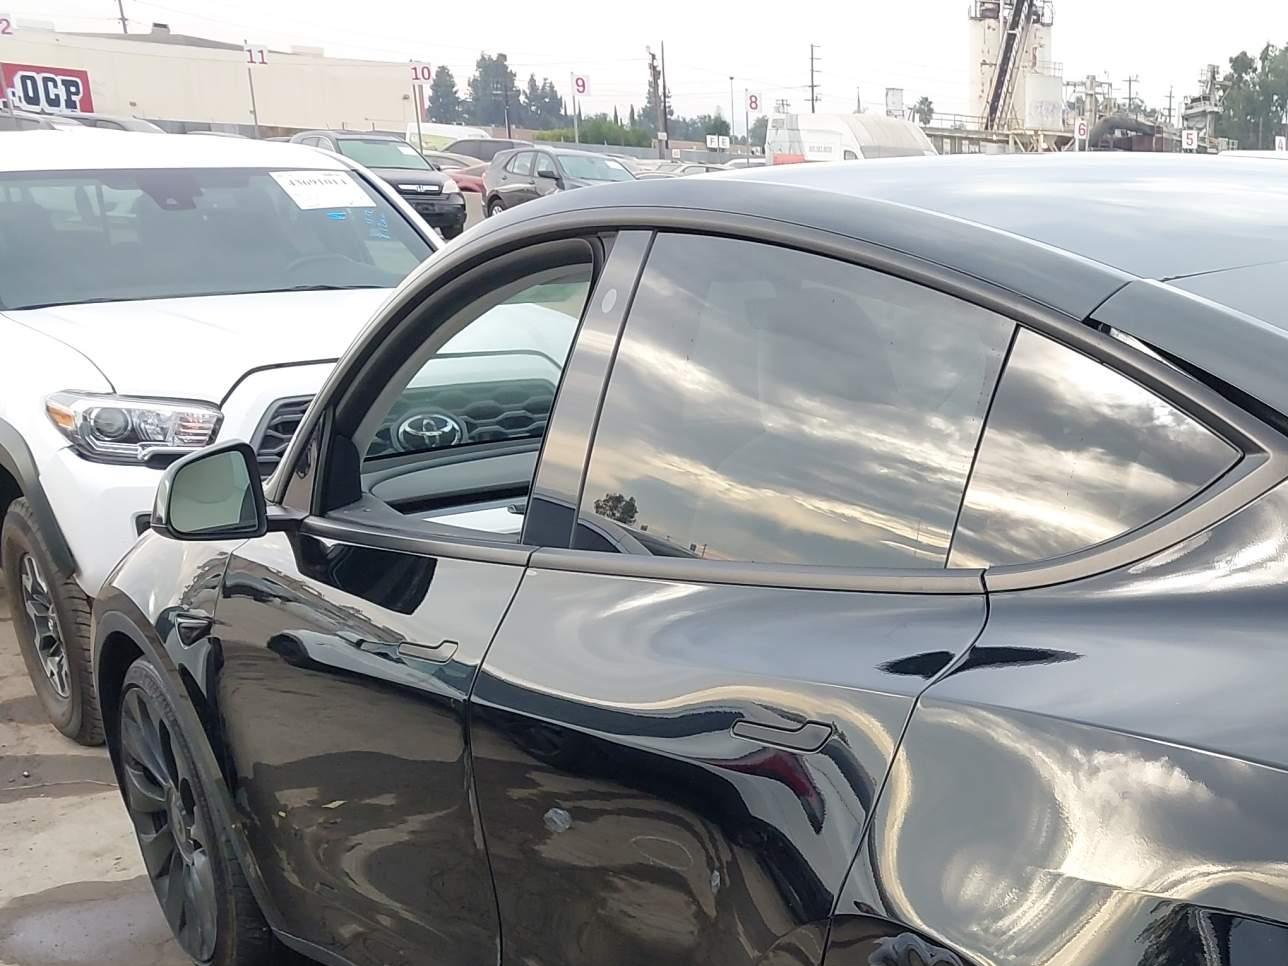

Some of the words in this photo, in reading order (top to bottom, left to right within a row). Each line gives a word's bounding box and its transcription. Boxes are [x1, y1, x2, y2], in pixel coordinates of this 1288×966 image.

[245, 48, 268, 65] 11
[410, 65, 431, 81] 10
[575, 77, 586, 94] 9
[749, 94, 759, 110] 8
[1078, 122, 1086, 136] 6
[709, 136, 717, 147] F
[1186, 132, 1194, 146] 5
